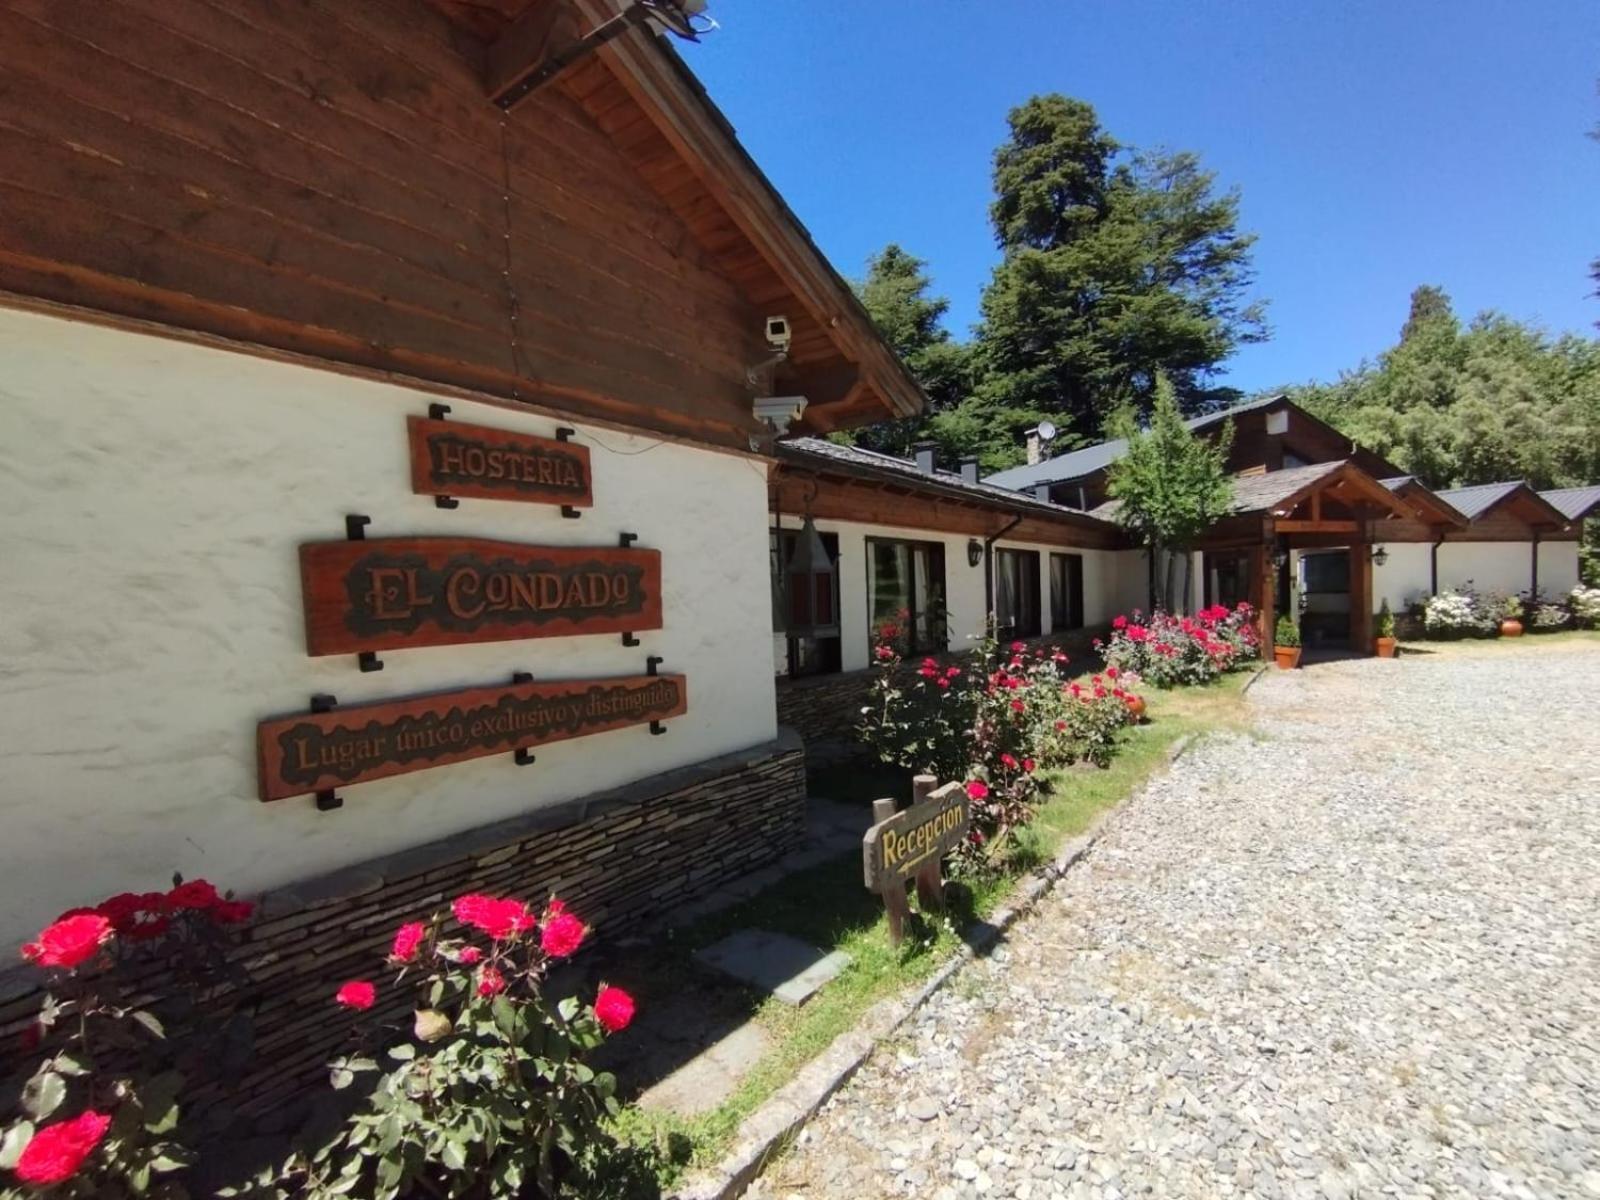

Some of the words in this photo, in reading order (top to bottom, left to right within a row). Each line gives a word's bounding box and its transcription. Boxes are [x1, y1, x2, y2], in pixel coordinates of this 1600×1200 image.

[366, 567, 433, 619] EL
[447, 567, 629, 619] CONDADO
[295, 737, 386, 770] Lugar
[571, 704, 584, 725] y
